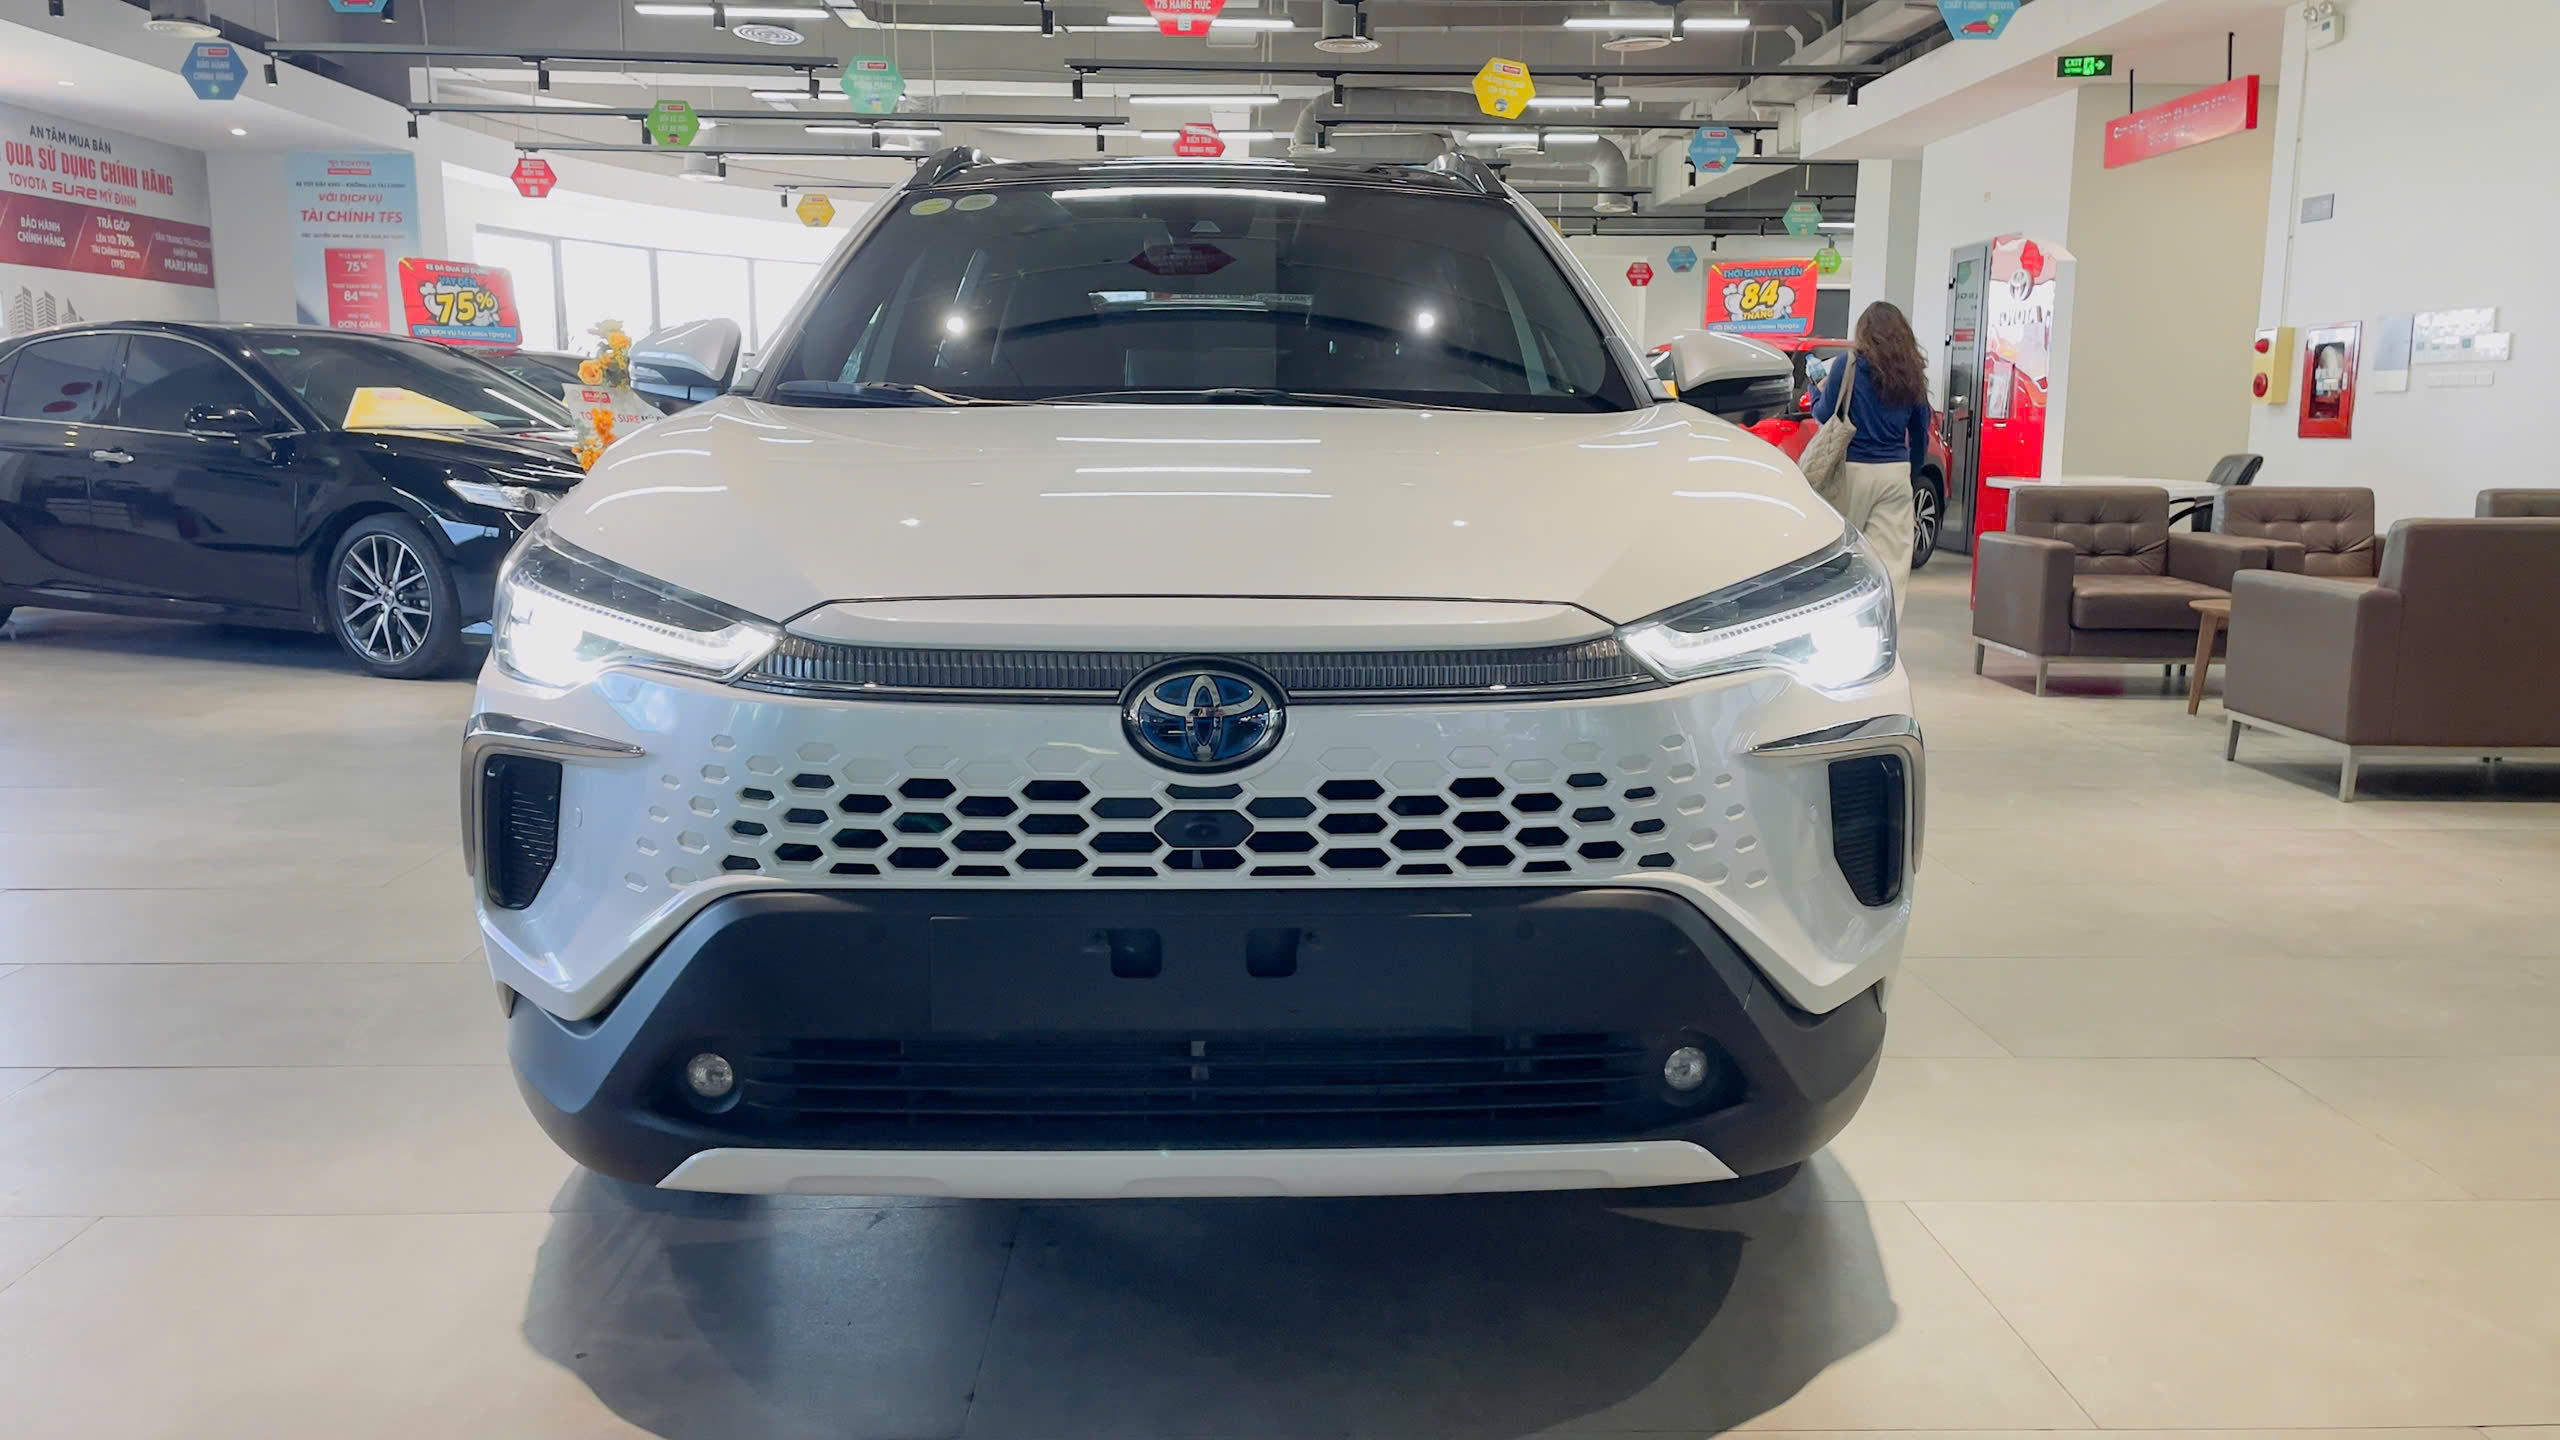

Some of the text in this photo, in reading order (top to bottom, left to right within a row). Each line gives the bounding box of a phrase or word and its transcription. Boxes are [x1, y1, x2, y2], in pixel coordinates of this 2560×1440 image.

[2064, 58, 2083, 67] EXIT
[30, 125, 112, 154] AN TÂM MUA BÁN
[5, 140, 174, 196] QUA SỬ DỤNG CHÍNH HÃNG
[8, 172, 48, 191] TOYOTA
[339, 193, 367, 206] DỊCH
[301, 207, 403, 223] TÀI CHÍNH TFS
[1744, 269, 1767, 278] GIAN
[1767, 269, 1783, 278] VAY
[343, 289, 359, 302] 84
[1740, 278, 1781, 312] 84
[434, 289, 497, 326] 75%
